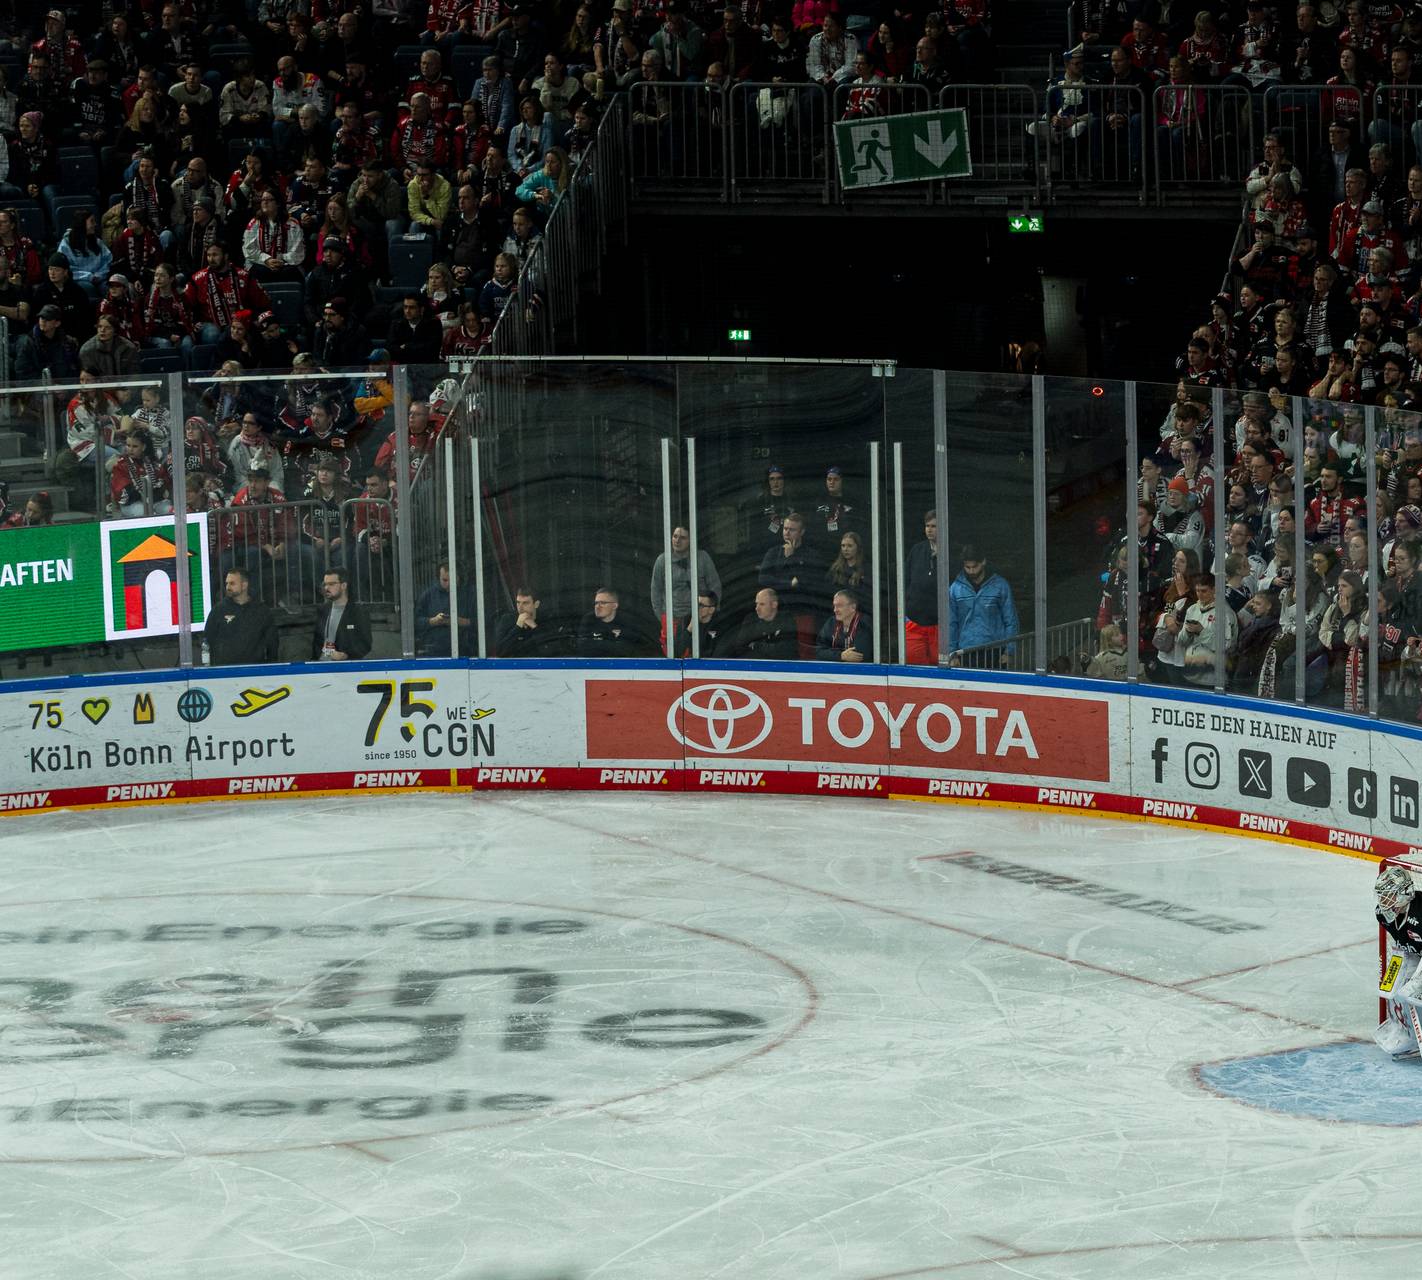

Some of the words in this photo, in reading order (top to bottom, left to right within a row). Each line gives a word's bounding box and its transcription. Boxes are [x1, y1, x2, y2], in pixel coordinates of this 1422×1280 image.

[29, 702, 63, 729] 75
[446, 707, 467, 721] WE
[788, 696, 1040, 760] TOYOTA
[1152, 707, 1206, 730] FOLGE
[1210, 714, 1245, 735] DEN
[1250, 720, 1303, 745] HAIEN
[1306, 730, 1337, 750] AUF
[31, 744, 92, 773] Köln
[106, 741, 173, 767] Bonn
[185, 732, 295, 766] Airport
[364, 751, 391, 760] since
[394, 749, 417, 760] 1950
[423, 723, 496, 758] CGN
